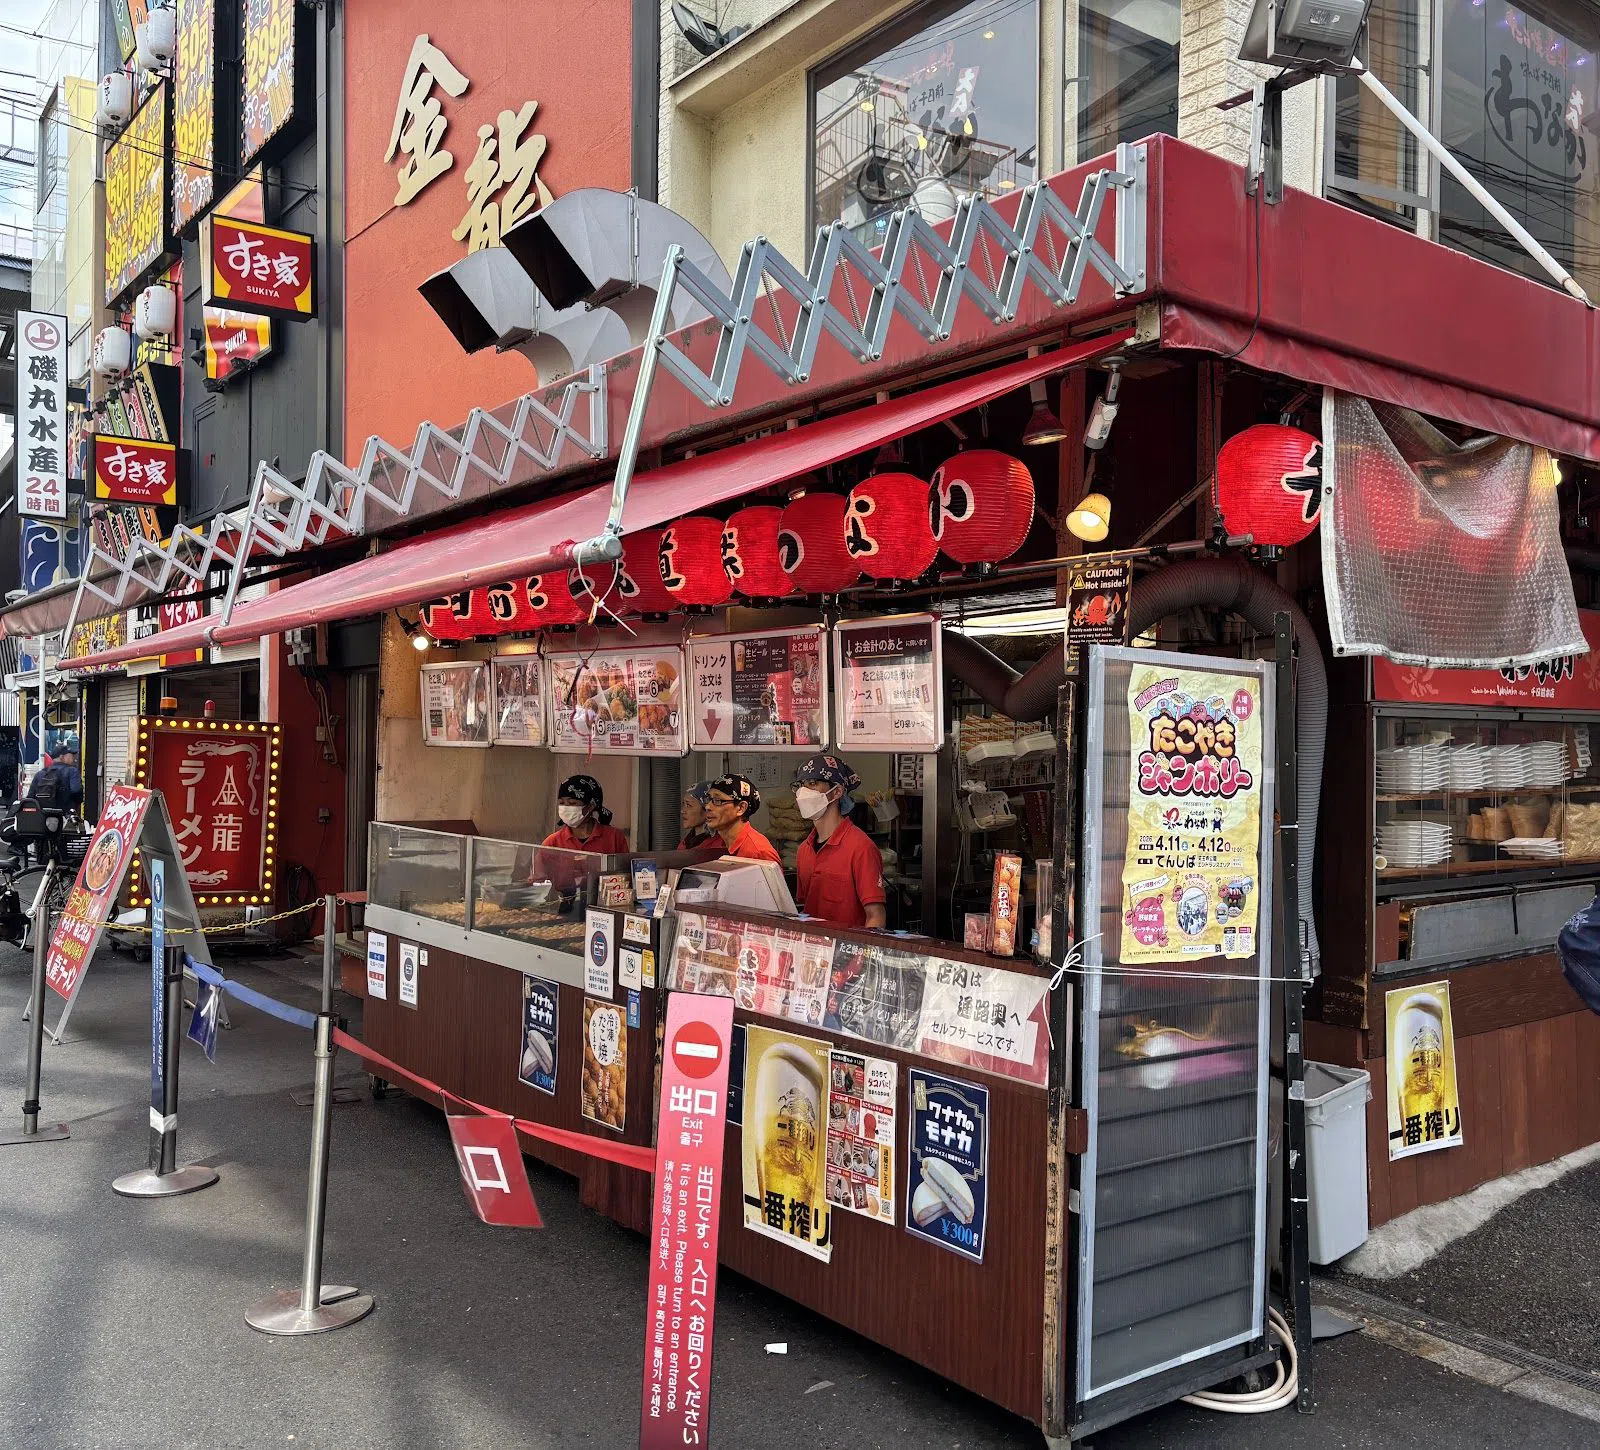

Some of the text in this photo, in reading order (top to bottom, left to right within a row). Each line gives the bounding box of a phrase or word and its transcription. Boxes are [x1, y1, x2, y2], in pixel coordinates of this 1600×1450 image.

[223, 232, 300, 288] すき家
[246, 285, 280, 298] SUKIYA
[224, 329, 248, 354] SUKIYA
[27, 355, 58, 474] 磯丸水産
[103, 445, 167, 488] すき家
[25, 476, 60, 496] 24
[122, 487, 151, 496] SUKIYA
[26, 496, 60, 513] 時間
[1085, 579, 1125, 590] Hot inside!
[1086, 568, 1122, 578] CAUTION!
[855, 638, 903, 653] お会計のあと
[694, 654, 727, 669] ドリンク
[700, 674, 722, 686] 注文は
[700, 691, 722, 704] レジで
[1152, 716, 1234, 758] たこやき
[1140, 754, 1251, 796] ジャンボリー
[176, 760, 206, 865] ラーメン
[212, 765, 244, 851] 金龍
[1156, 836, 1180, 851] 4.11
[1198, 837, 1224, 852] 4.12
[1156, 855, 1196, 868] てんしば
[937, 962, 982, 988] 店内は
[530, 1004, 553, 1025] モナカ
[531, 992, 554, 1012] ワナカの
[931, 1021, 1018, 1054] セルフサービスです。
[669, 1085, 717, 1117] 出口
[682, 1116, 703, 1130] Exit
[929, 1100, 974, 1132] ワナカの
[1390, 1107, 1460, 1145] 一番搾り
[679, 1132, 703, 1148] 출구
[926, 1120, 972, 1154] モナカ
[744, 1190, 830, 1248] 一番搾り
[941, 1218, 972, 1245] ¥300
[667, 1163, 691, 1412] It is an exit. Please turn to an entrance.
